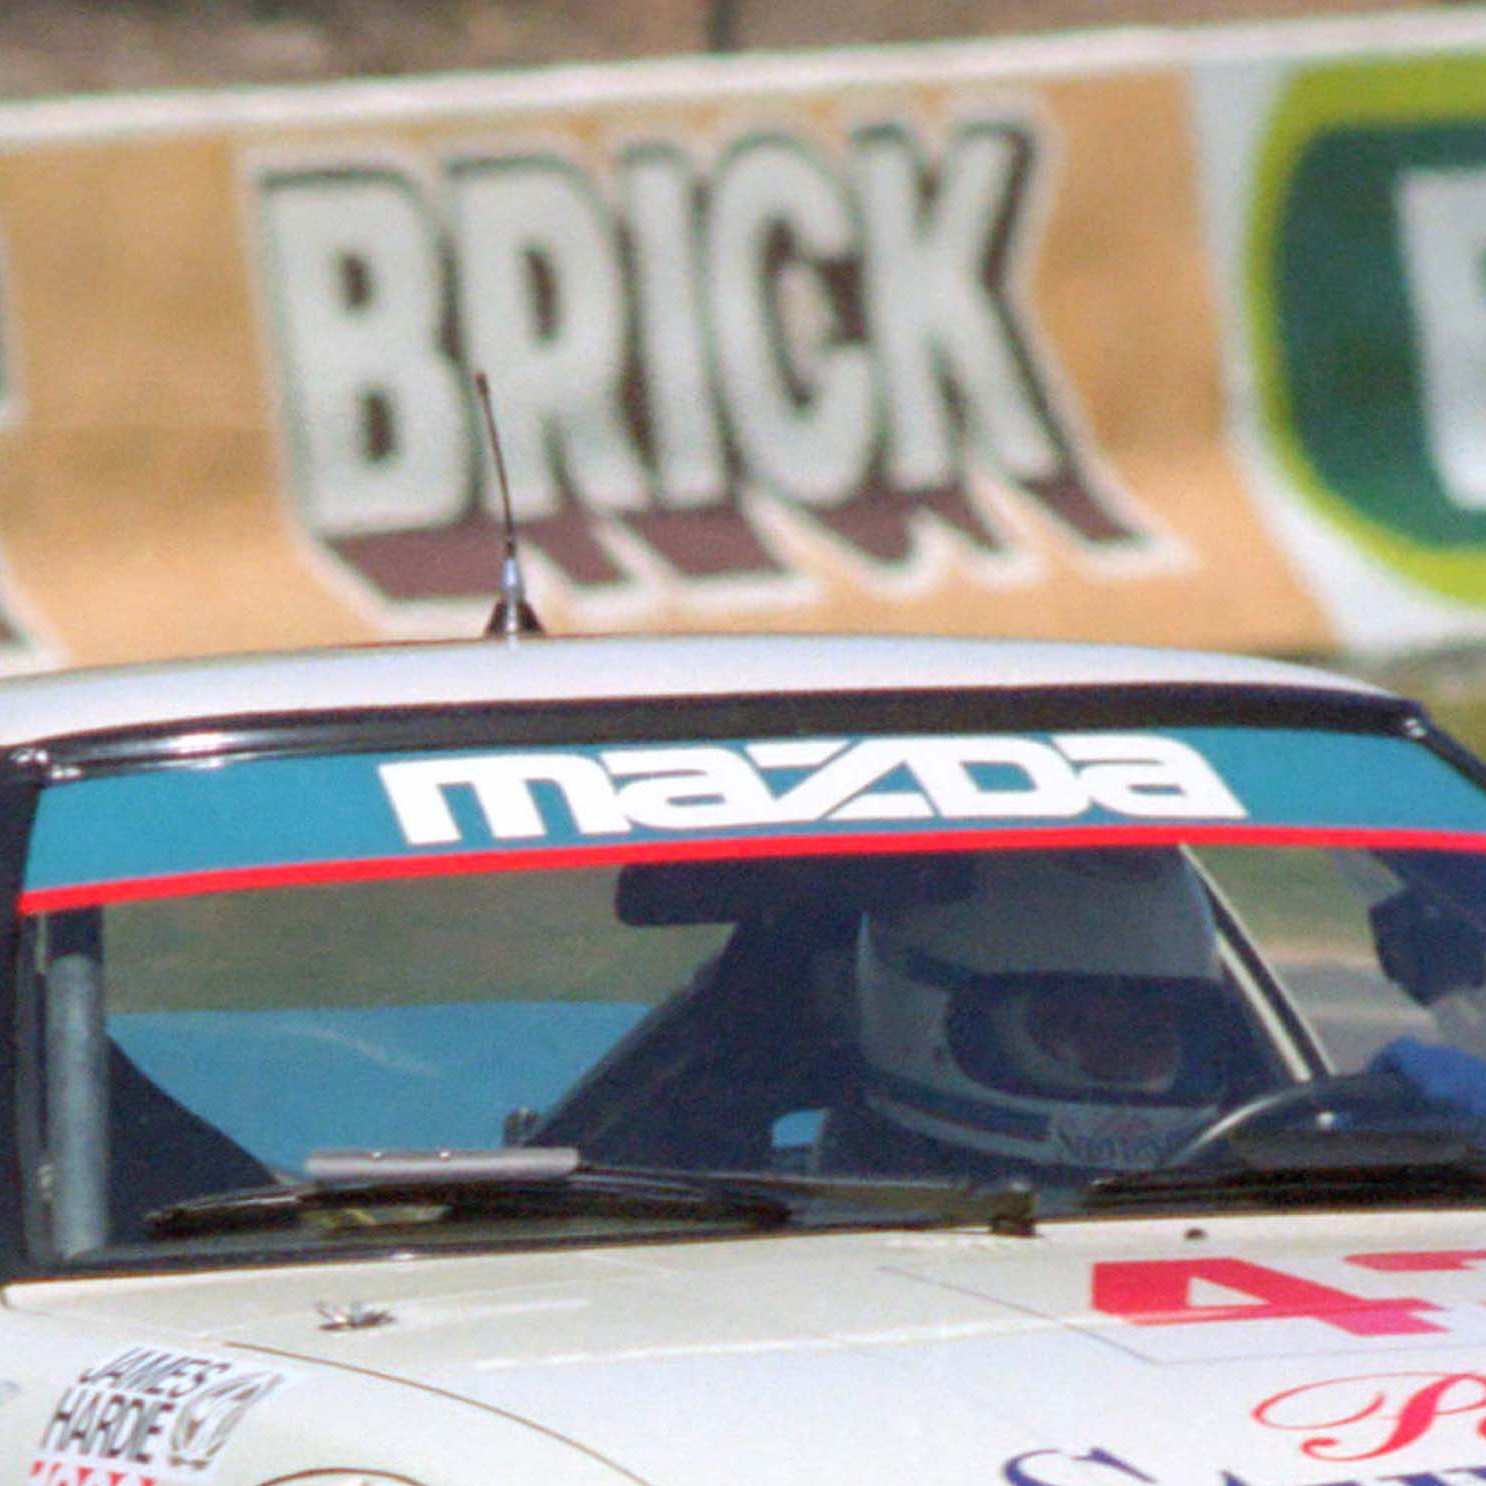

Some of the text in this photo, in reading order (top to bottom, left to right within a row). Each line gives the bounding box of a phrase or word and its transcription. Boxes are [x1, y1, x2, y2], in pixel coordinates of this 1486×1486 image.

[254, 122, 1114, 597] BRICK
[77, 1346, 233, 1400] JAMES
[39, 1386, 176, 1466] HARDIE
